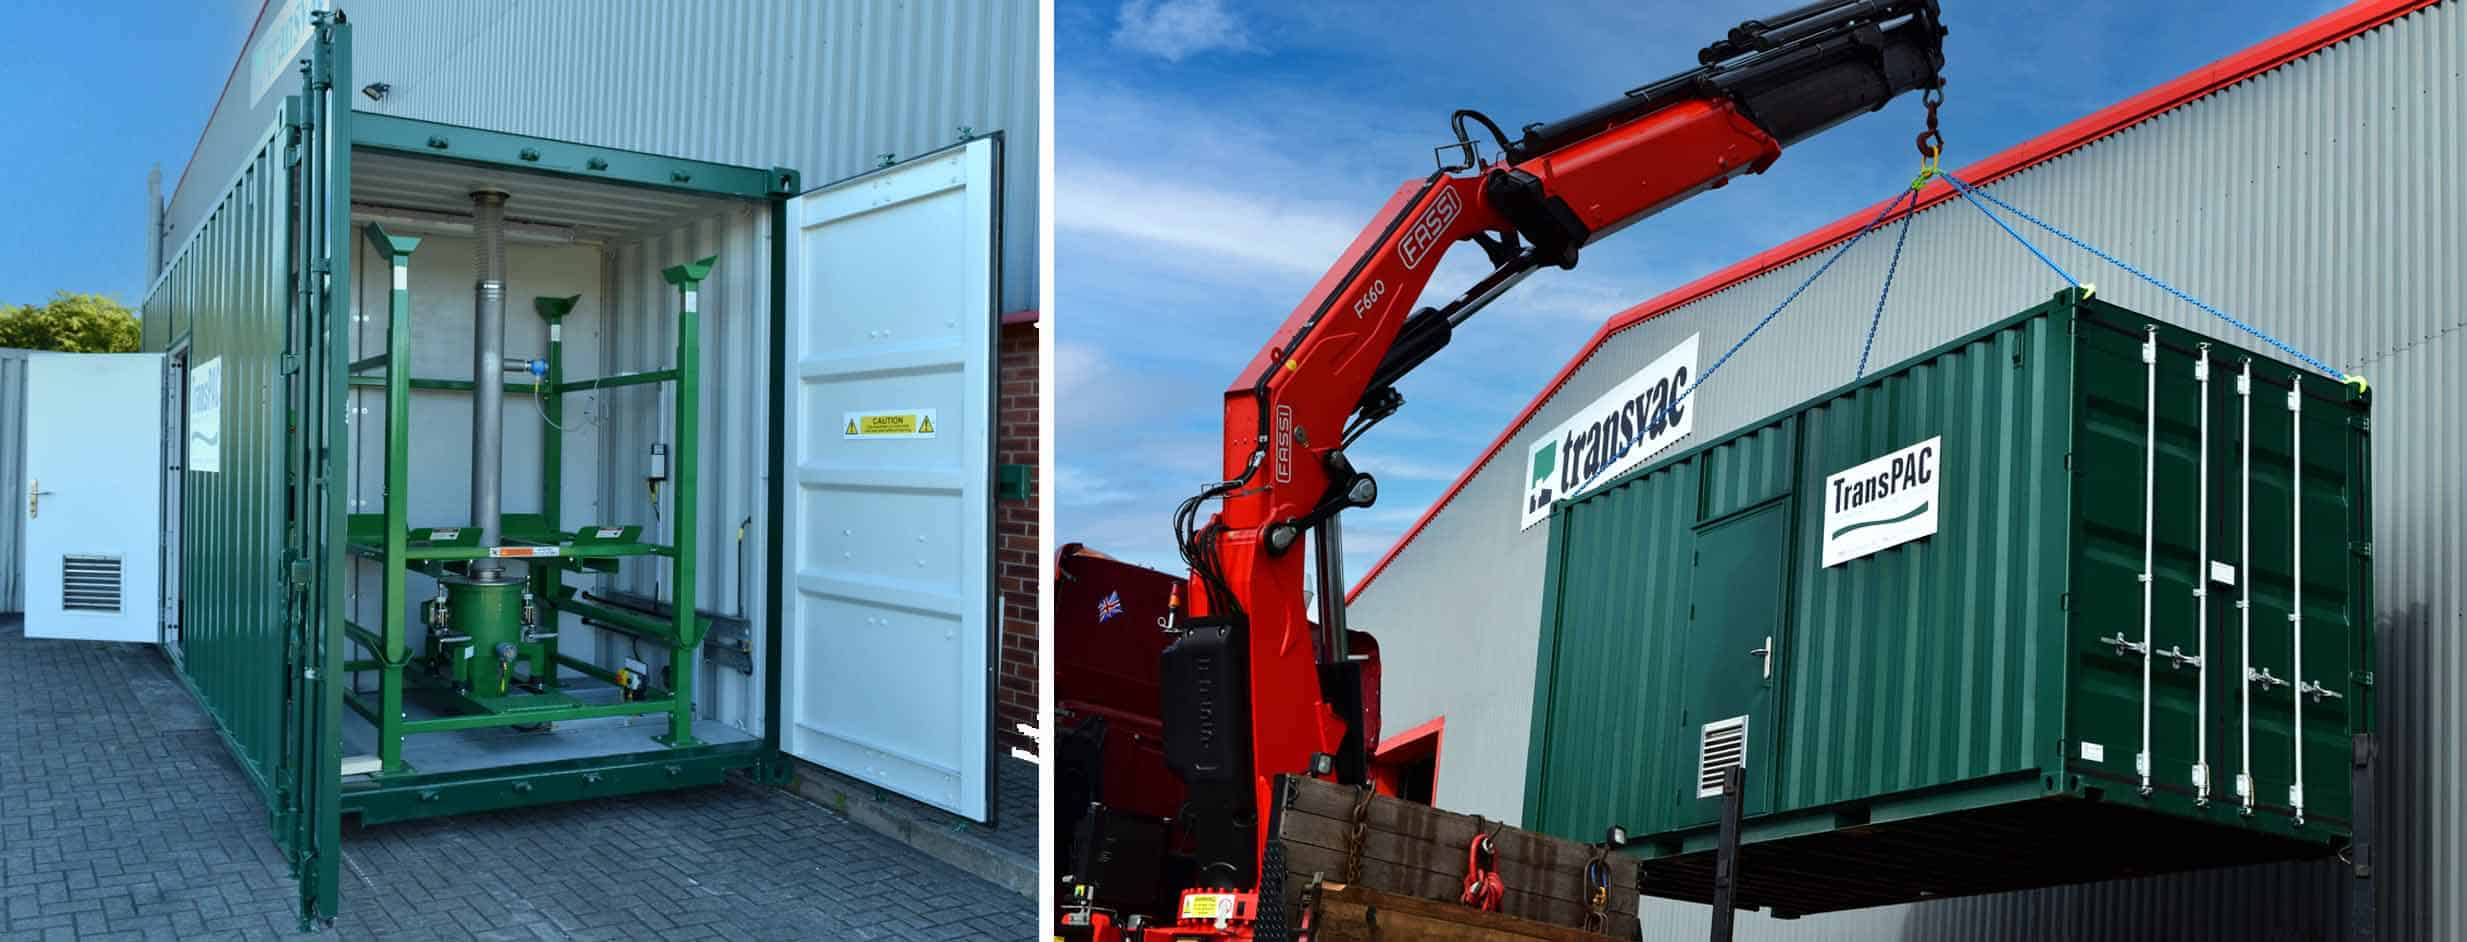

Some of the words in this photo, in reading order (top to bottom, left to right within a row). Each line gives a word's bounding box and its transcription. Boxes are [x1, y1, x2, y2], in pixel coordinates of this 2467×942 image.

[1402, 191, 1458, 263] FASSI
[1353, 279, 1385, 320] F660
[872, 416, 904, 425] CAUTION
[1278, 411, 1290, 476] FASSI
[1560, 366, 1688, 495] transvac
[1833, 446, 1932, 514] TransPAC
